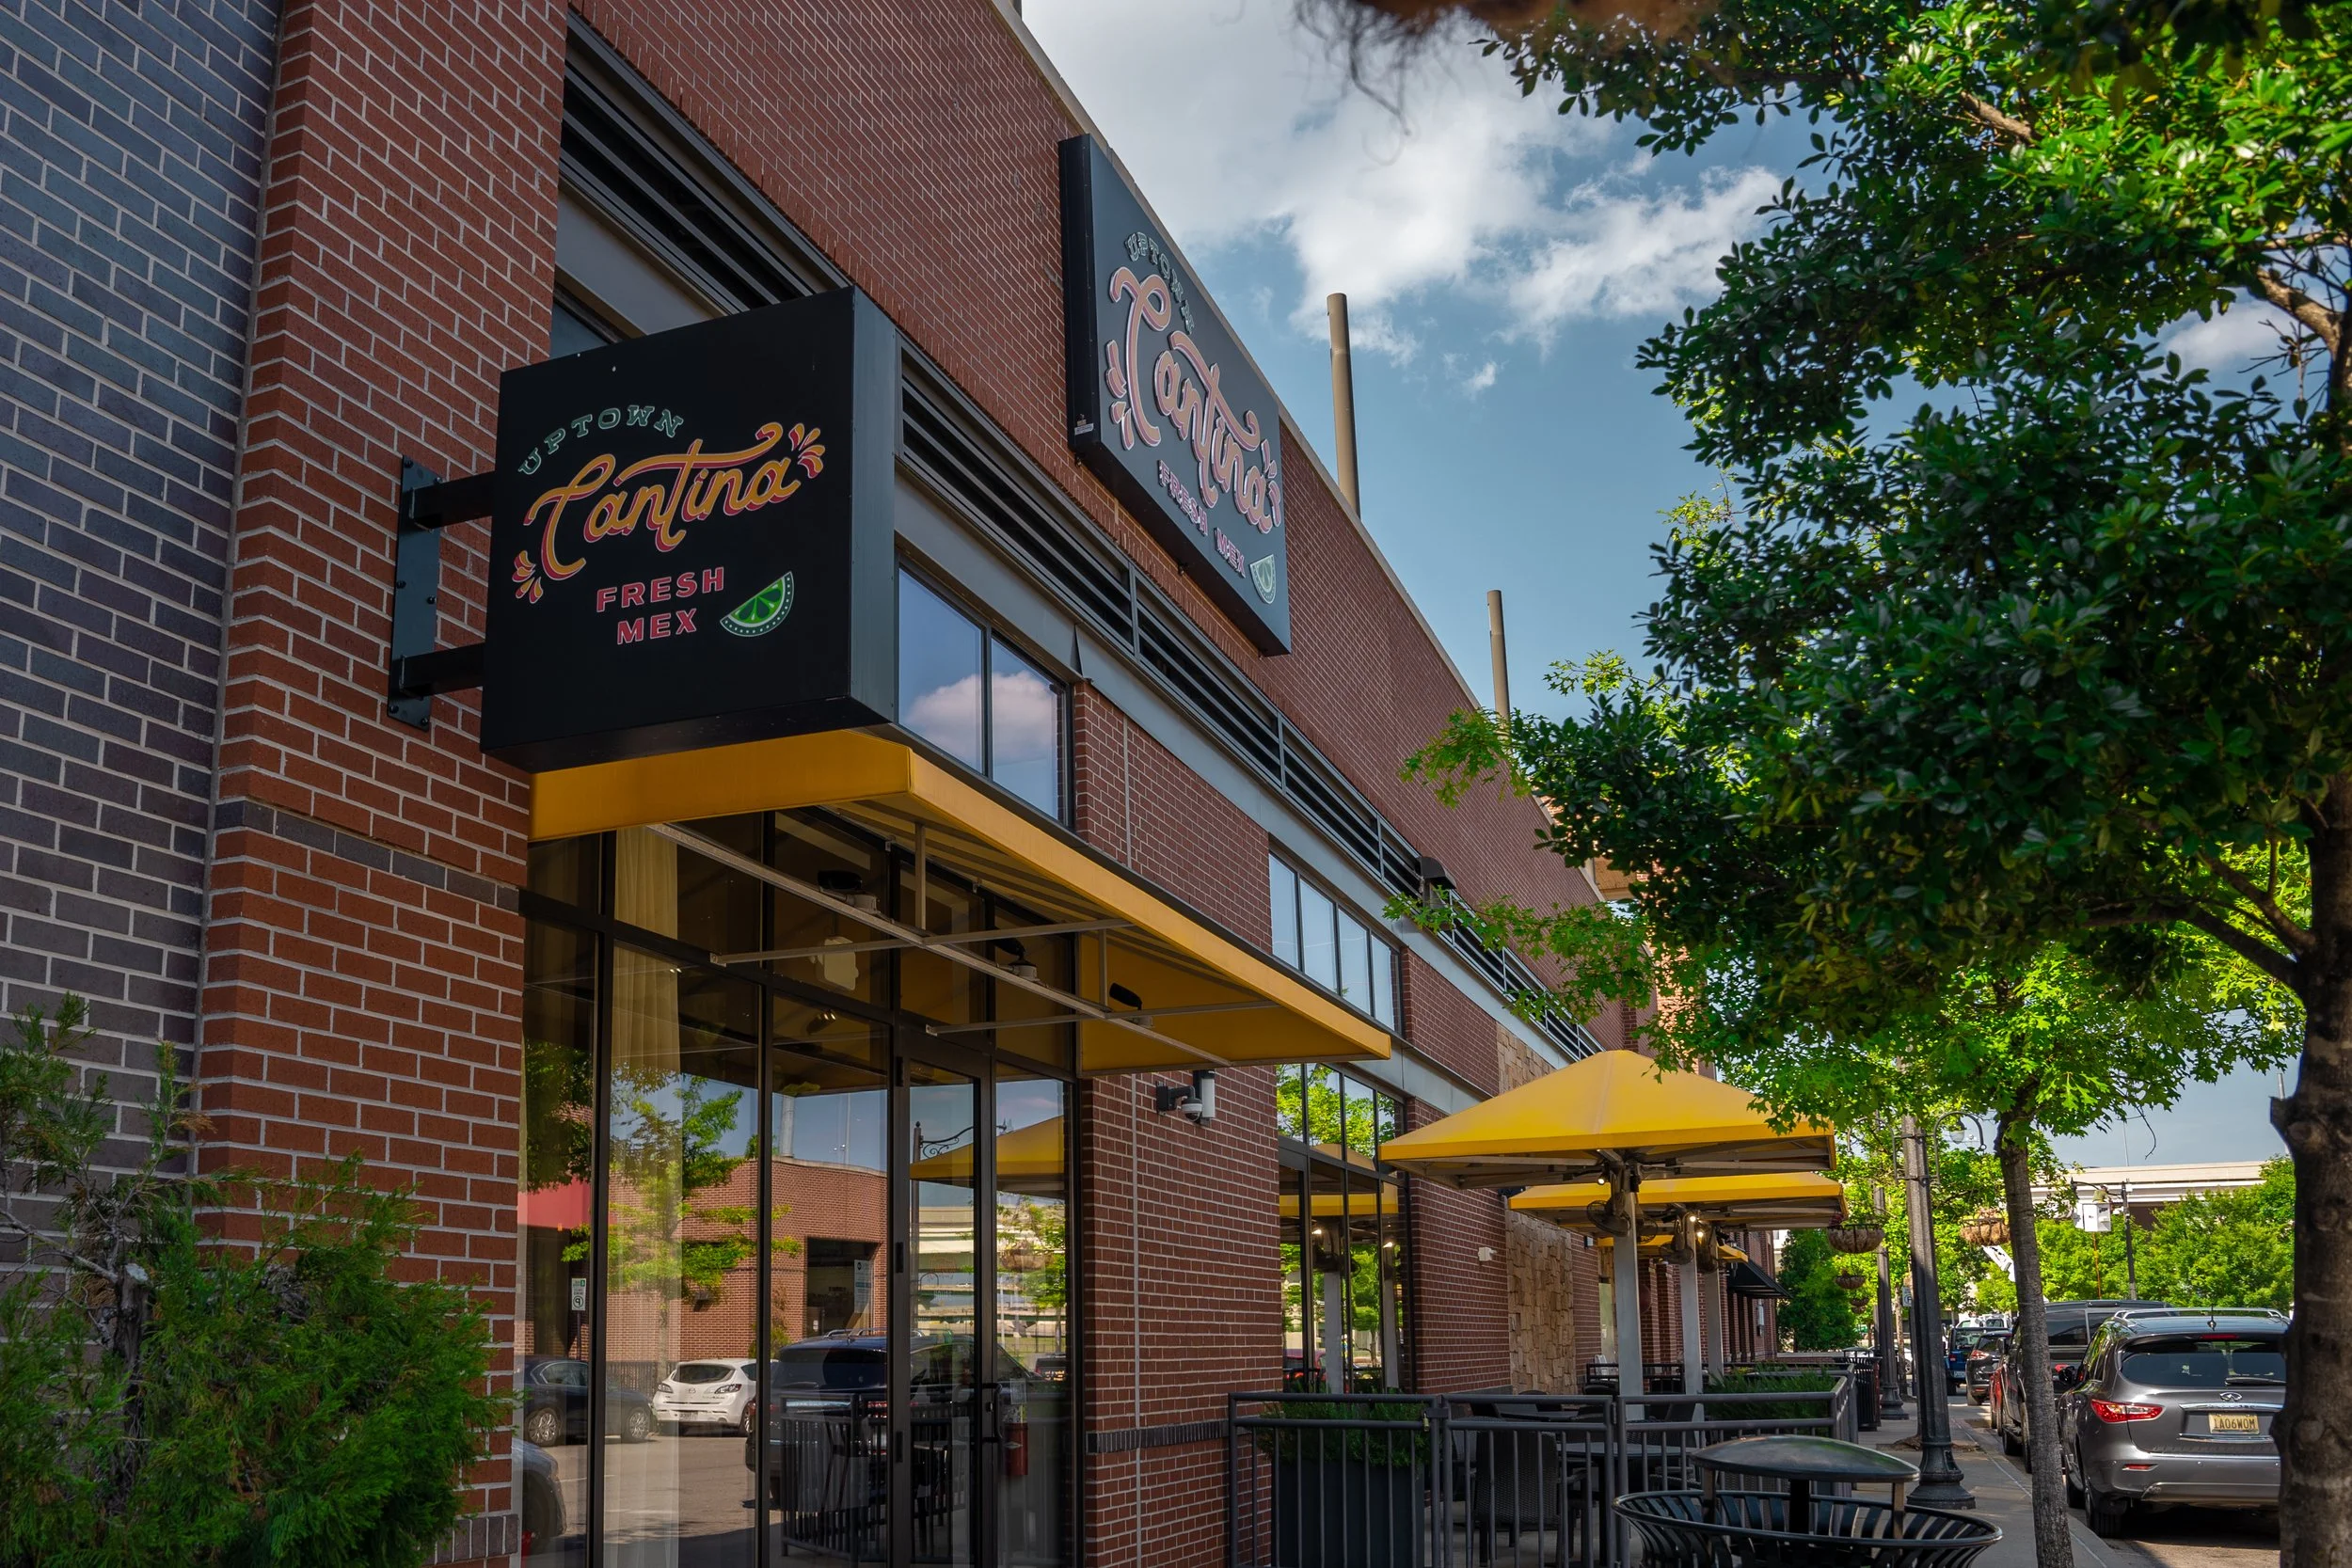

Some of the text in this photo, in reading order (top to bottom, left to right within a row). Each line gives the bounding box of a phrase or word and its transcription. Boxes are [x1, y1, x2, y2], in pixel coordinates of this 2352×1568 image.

[1124, 231, 1195, 335] UPTOWN
[518, 404, 684, 475] UPTOWN
[1109, 266, 1273, 534] Cantina
[523, 422, 801, 580] Cantina
[1158, 460, 1246, 578] FRESH MEX
[596, 566, 724, 612] FRESH
[617, 608, 697, 645] MEX
